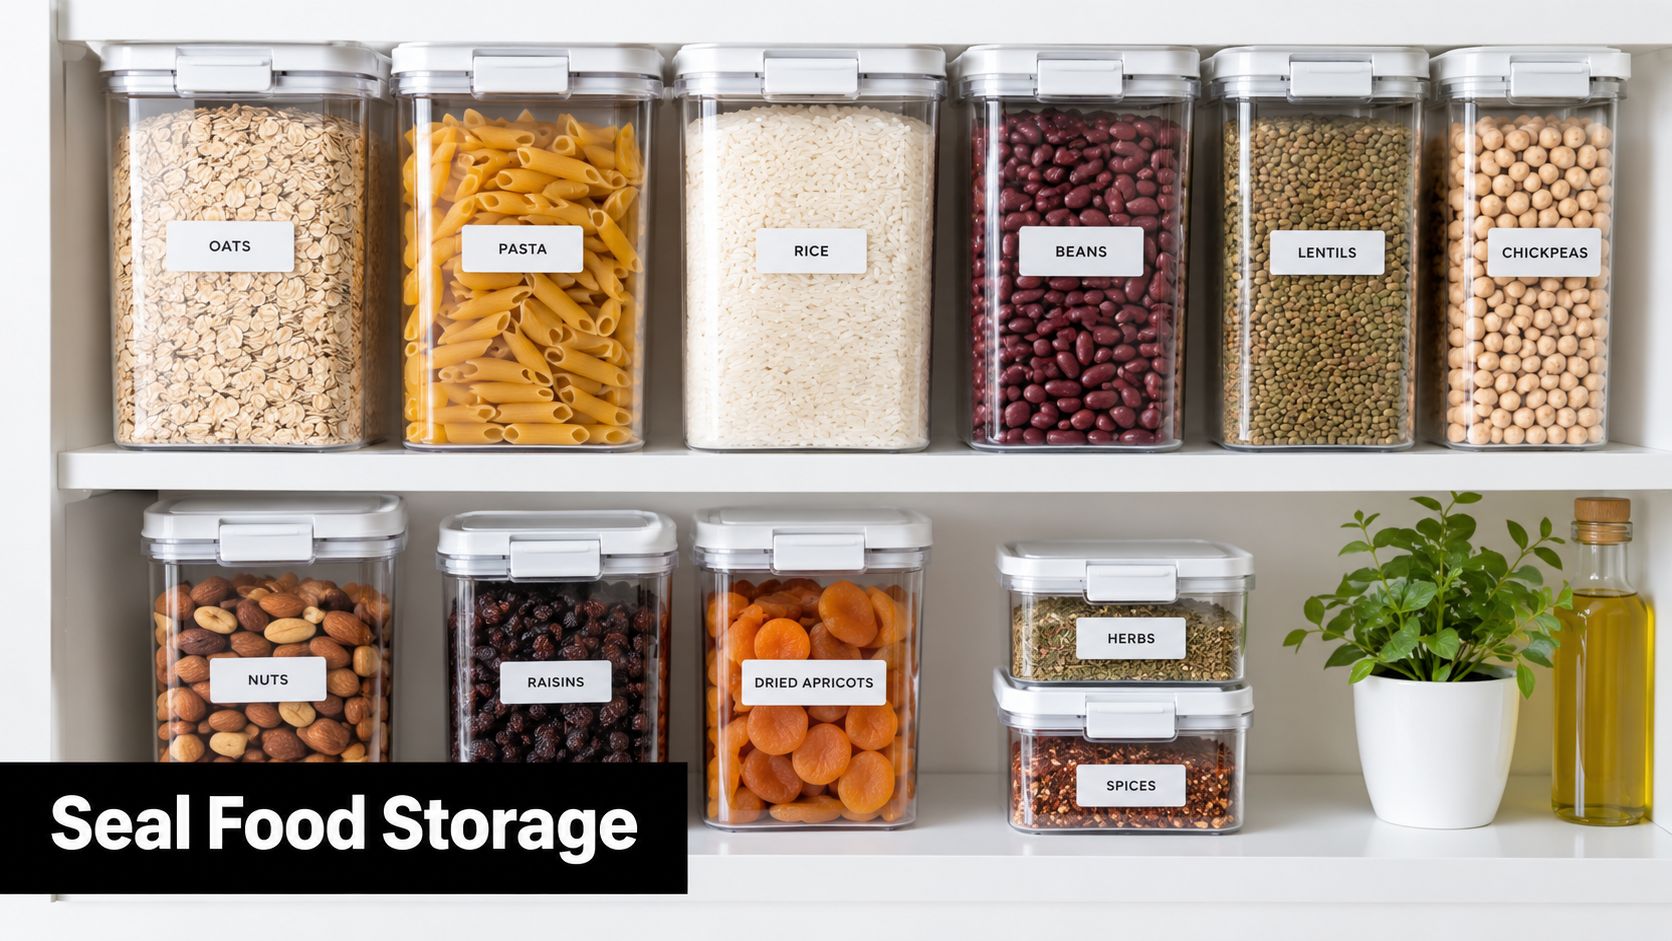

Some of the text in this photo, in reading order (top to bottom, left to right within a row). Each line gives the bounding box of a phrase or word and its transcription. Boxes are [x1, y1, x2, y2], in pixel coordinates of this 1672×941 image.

[209, 240, 251, 253] OATS
[498, 243, 548, 255] PASTA
[794, 245, 829, 257] RICE
[1055, 245, 1108, 258] BEANS
[1298, 246, 1357, 259] LENTILS
[1502, 246, 1589, 259] CHICKPEAS
[1107, 632, 1156, 644] HERBS
[248, 673, 289, 686] NUTS
[527, 676, 585, 688] RAISINS
[754, 677, 874, 689] DRIED APRICOTS
[1106, 780, 1156, 792] SPICES
